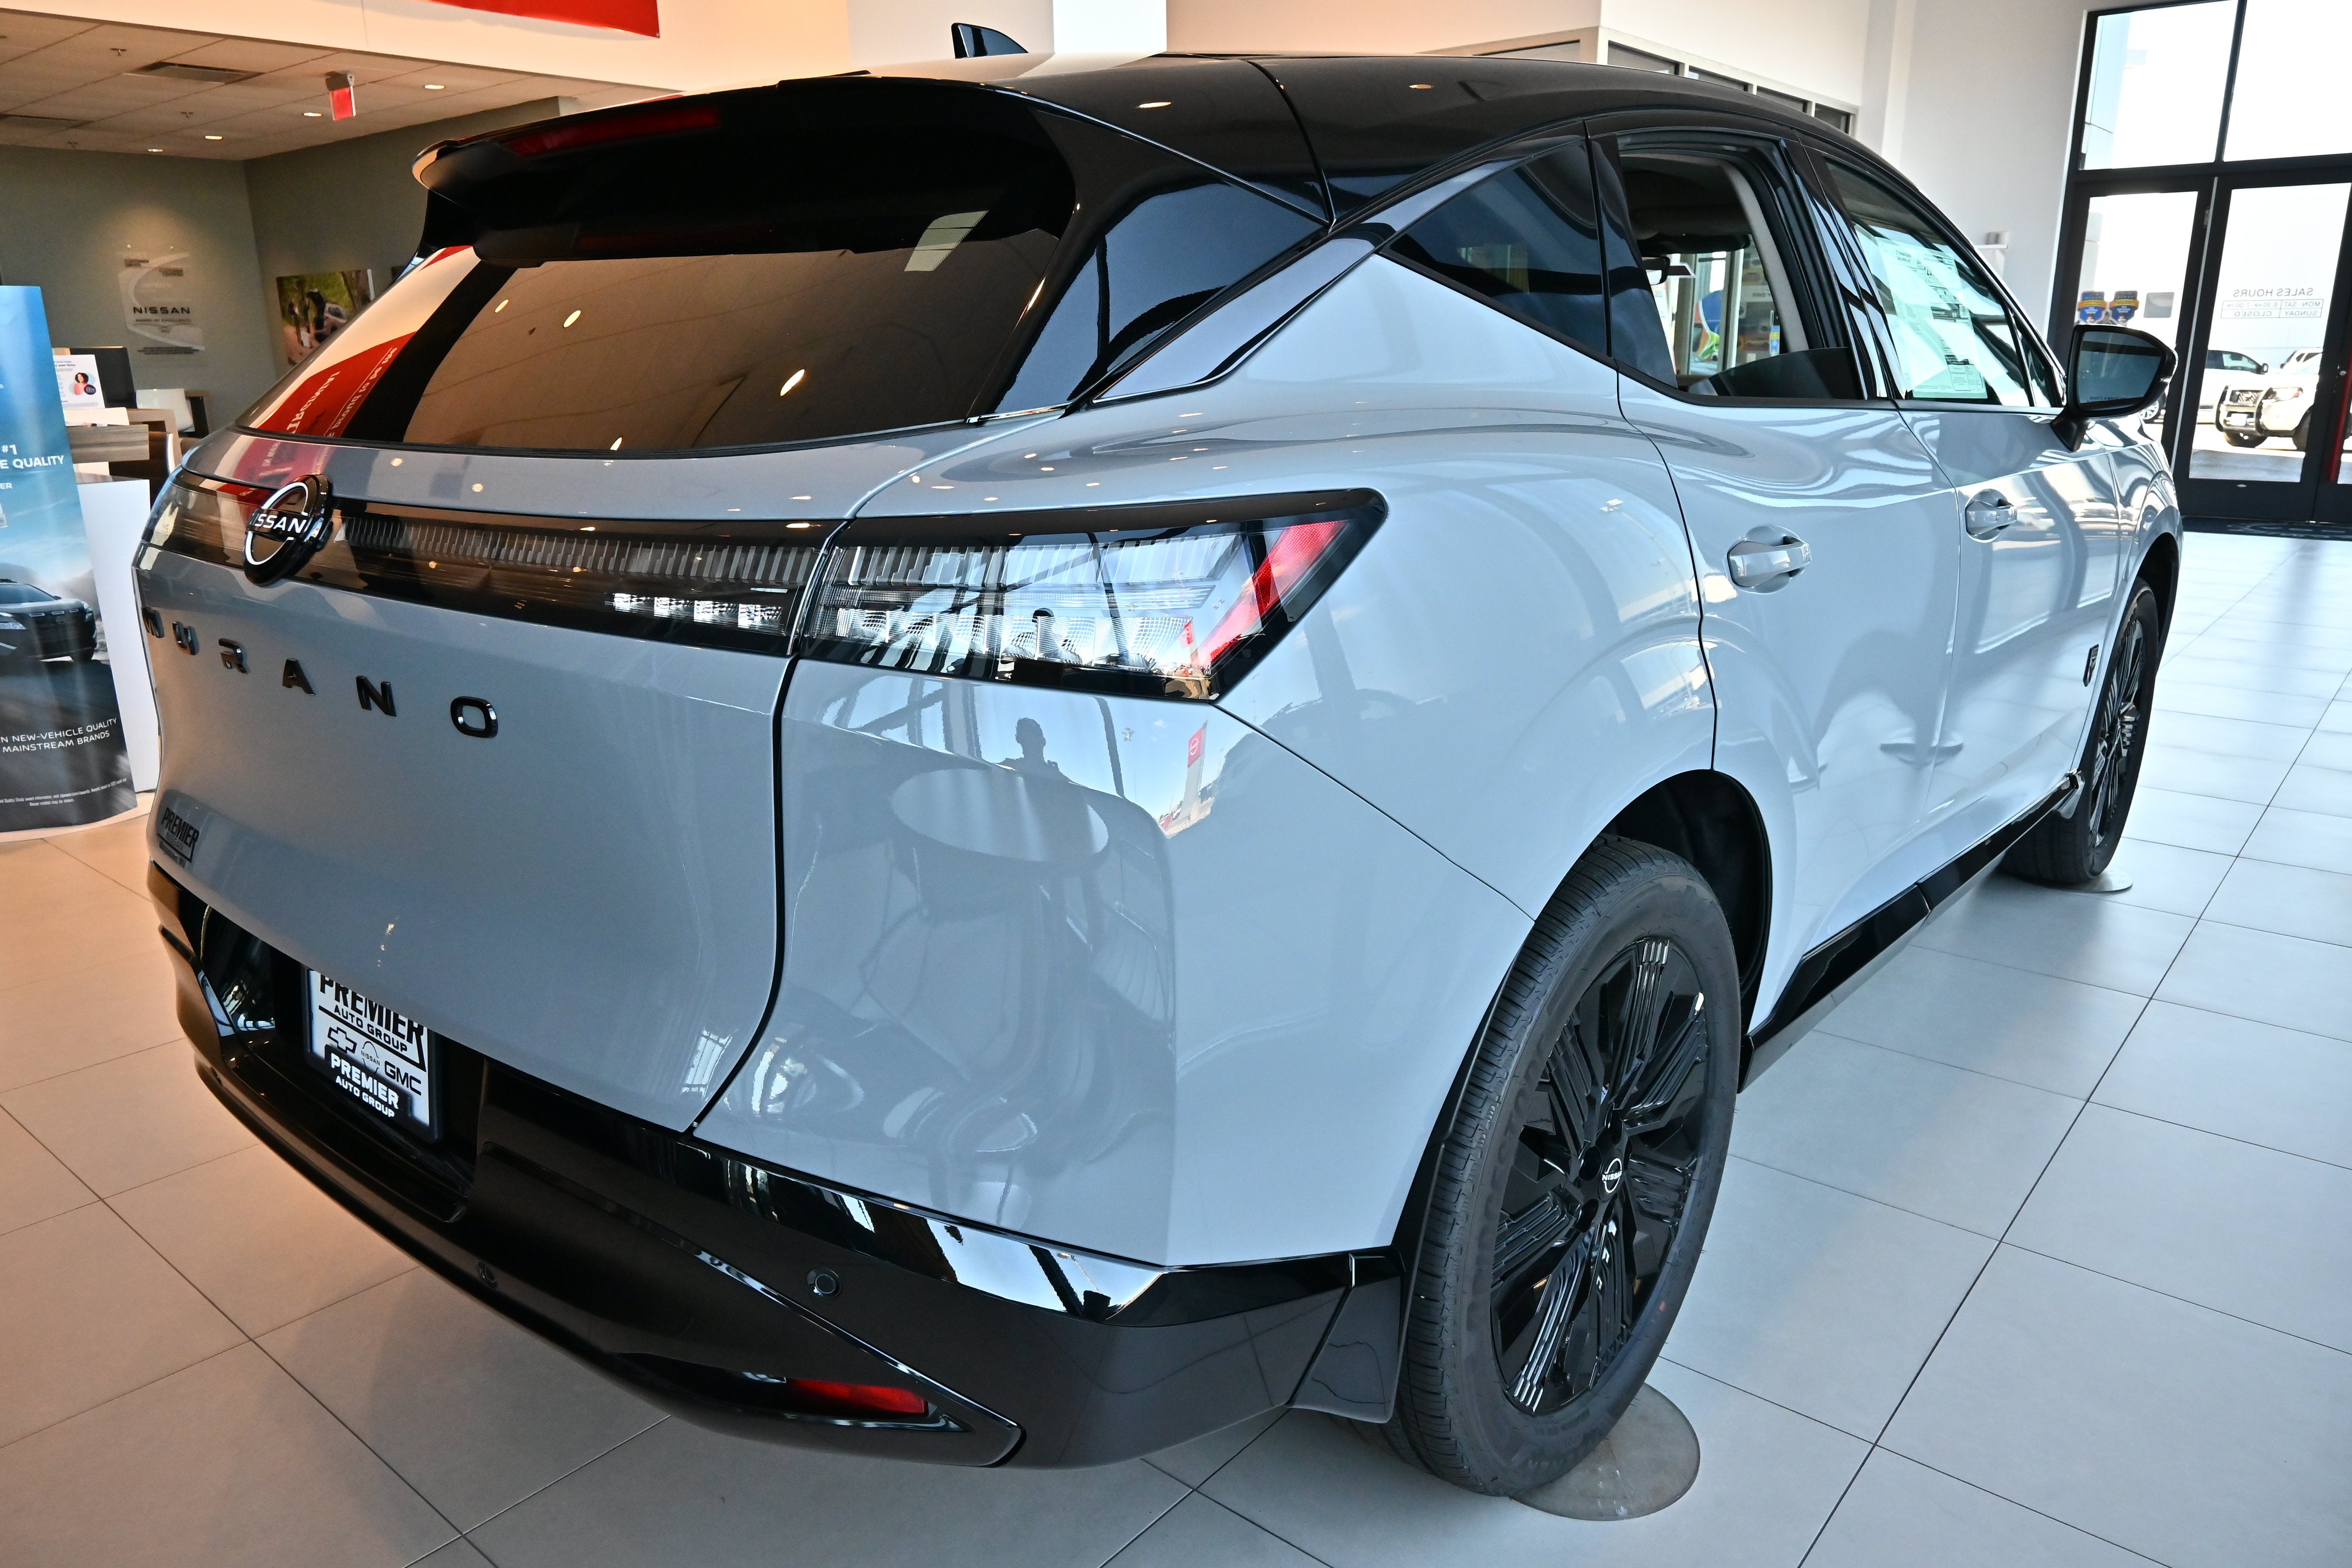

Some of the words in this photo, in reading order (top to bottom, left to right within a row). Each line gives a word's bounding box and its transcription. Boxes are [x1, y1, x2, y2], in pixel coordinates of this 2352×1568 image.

[2, 444, 17, 455] #1
[13, 455, 64, 469] QUALITY
[142, 607, 498, 738] MURANO
[3, 739, 74, 753] MAINSTREAM
[77, 730, 110, 745] BRANDS
[12, 727, 84, 742] NEW-VEHICLE
[86, 718, 117, 732] QUALITY
[162, 807, 200, 848] PREMIER
[320, 972, 425, 1046] PREMIER
[335, 1004, 363, 1029] AUTO
[367, 1023, 408, 1052] GROUP
[361, 1050, 380, 1066] NISSAN
[331, 1053, 399, 1109] PREMIER
[335, 1075, 360, 1097] AUTO
[362, 1093, 395, 1118] GROUP
[385, 1060, 422, 1096] GMC
